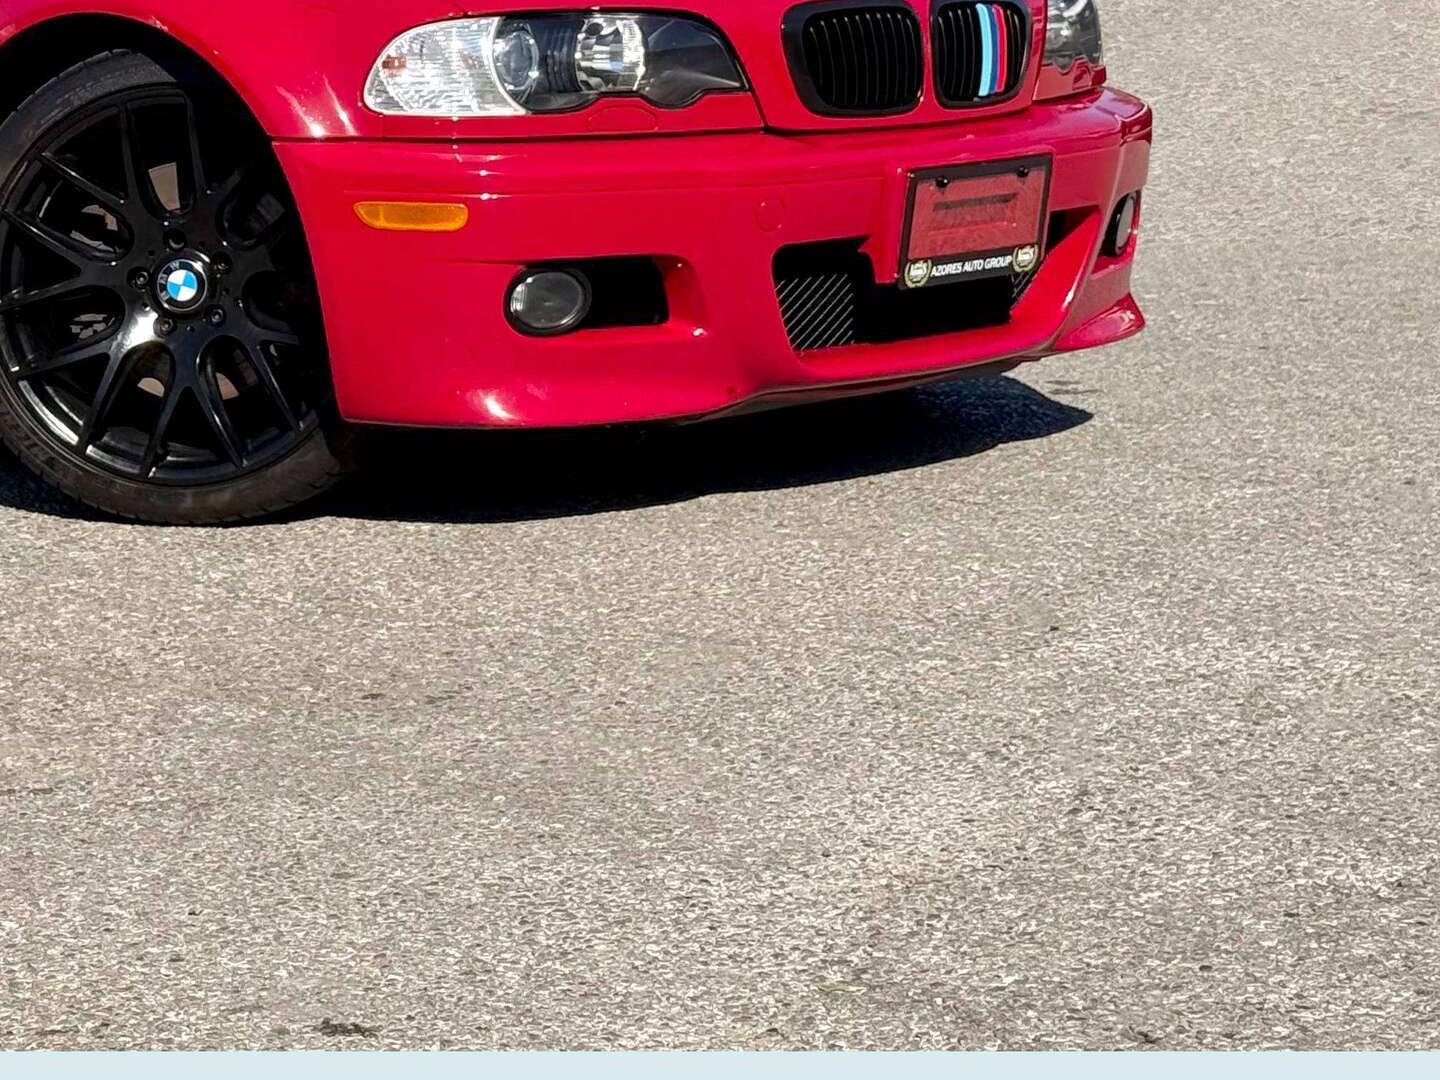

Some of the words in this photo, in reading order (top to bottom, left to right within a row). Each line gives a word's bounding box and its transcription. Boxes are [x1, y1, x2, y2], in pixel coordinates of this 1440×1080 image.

[930, 263, 962, 277] AZORES
[962, 259, 983, 272] AUTO
[984, 255, 1013, 269] GROUP
